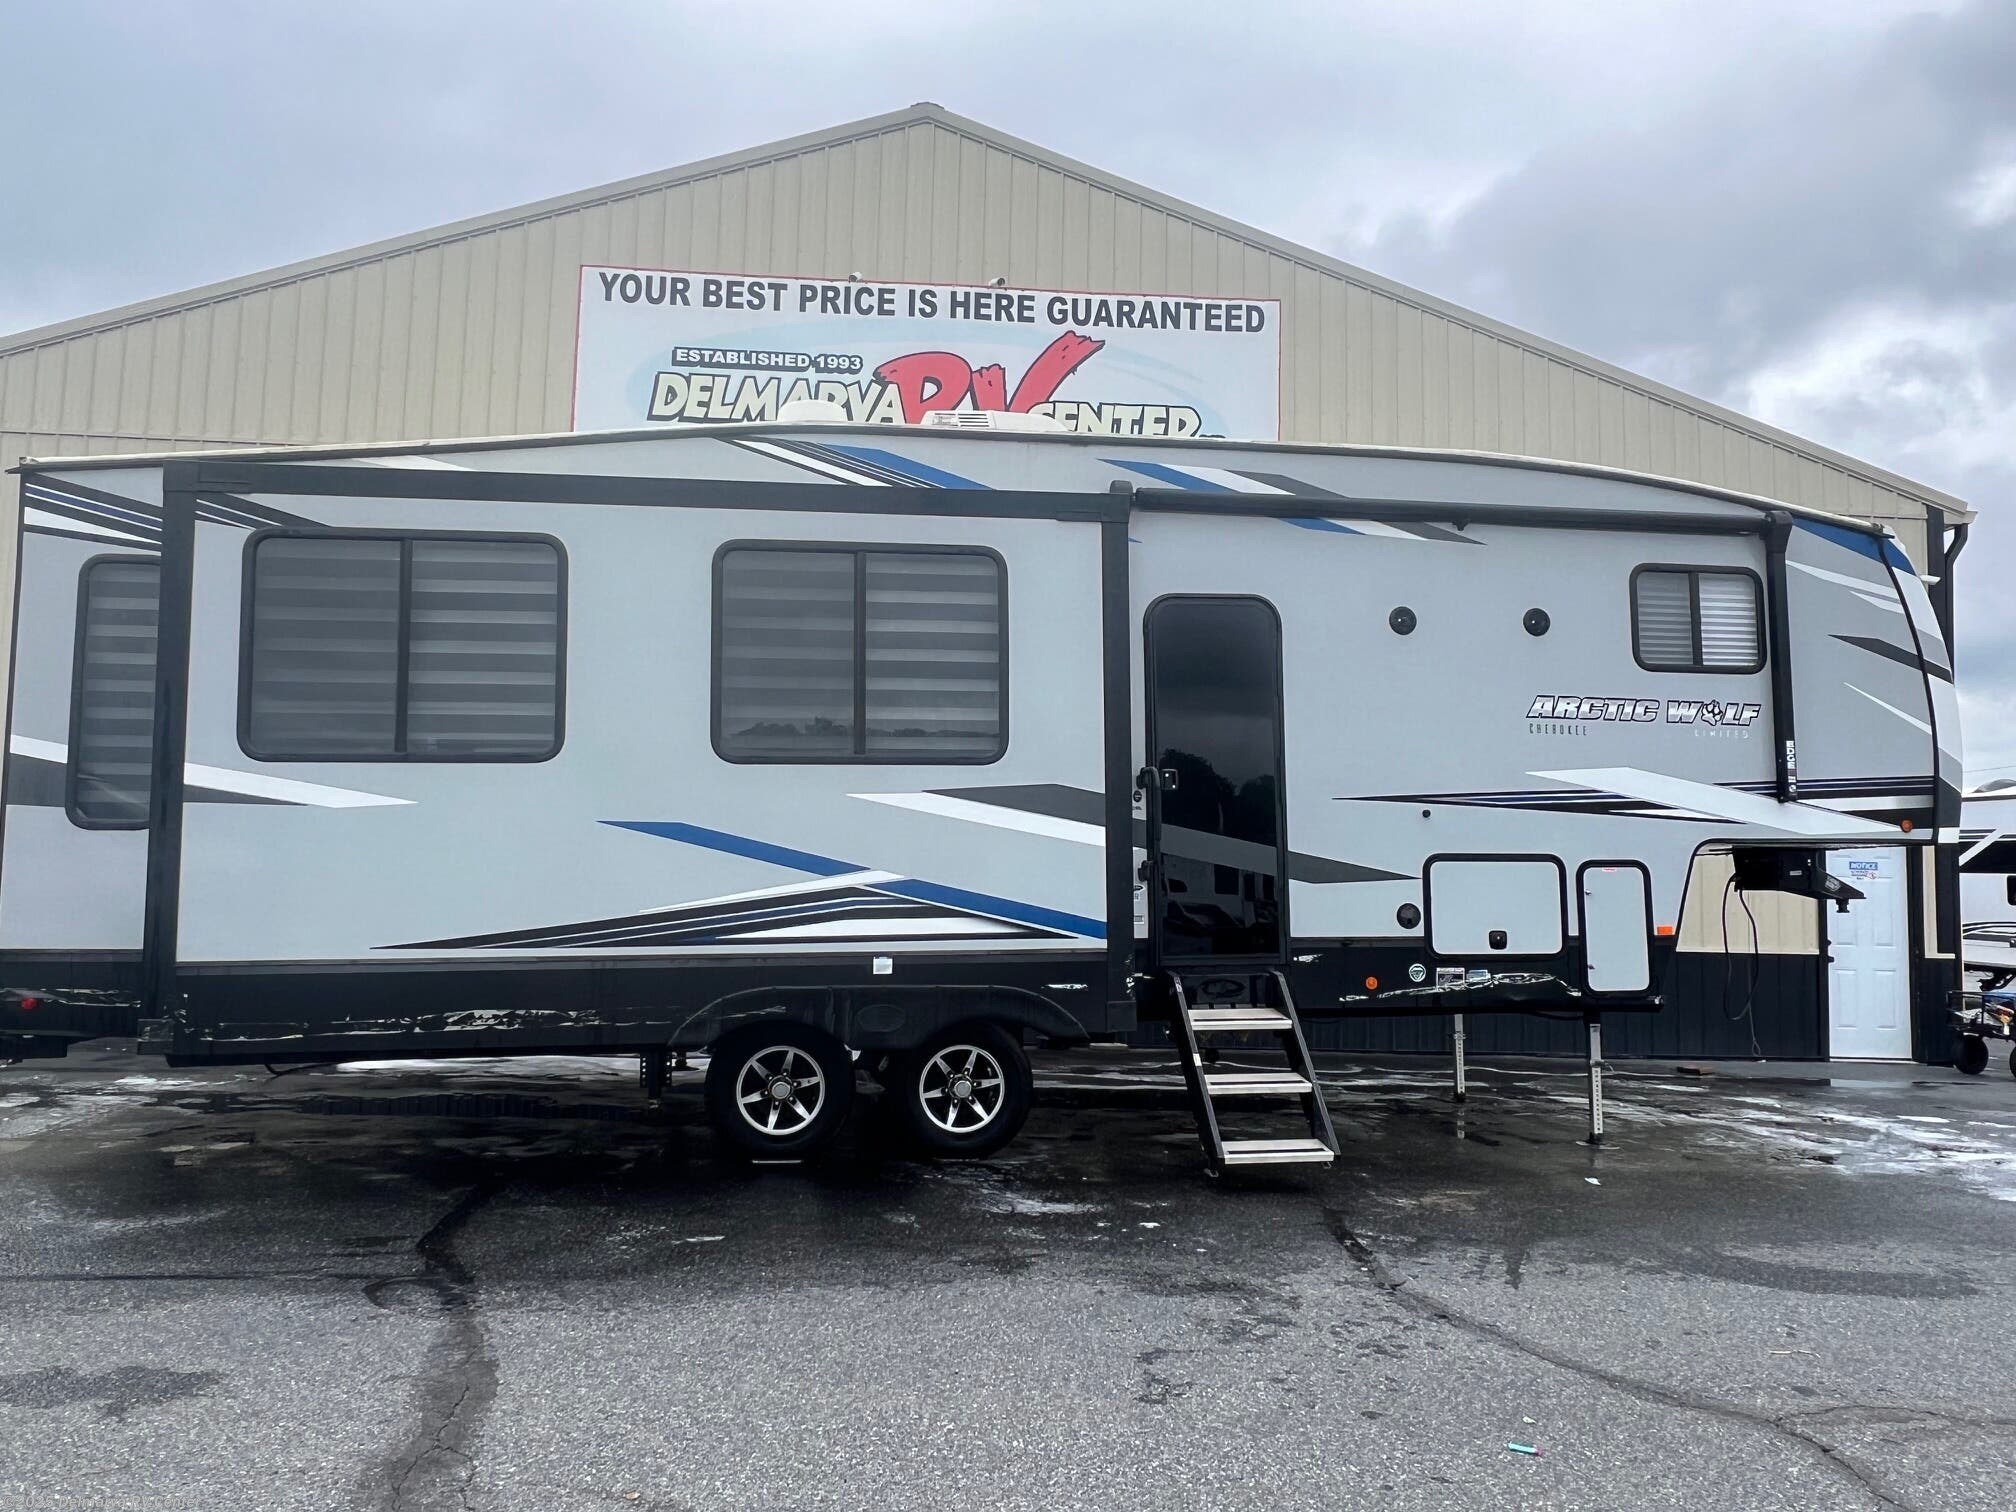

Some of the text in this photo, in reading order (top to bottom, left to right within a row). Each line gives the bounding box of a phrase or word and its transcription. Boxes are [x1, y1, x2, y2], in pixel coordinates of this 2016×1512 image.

[599, 271, 1265, 333] YOUR BEST PRICE IS HERE GUARANTEED
[675, 348, 862, 371] ESTABLISHED 1993
[1526, 695, 1660, 722] ARCTIC
[1529, 722, 1587, 736] CHEROKEE
